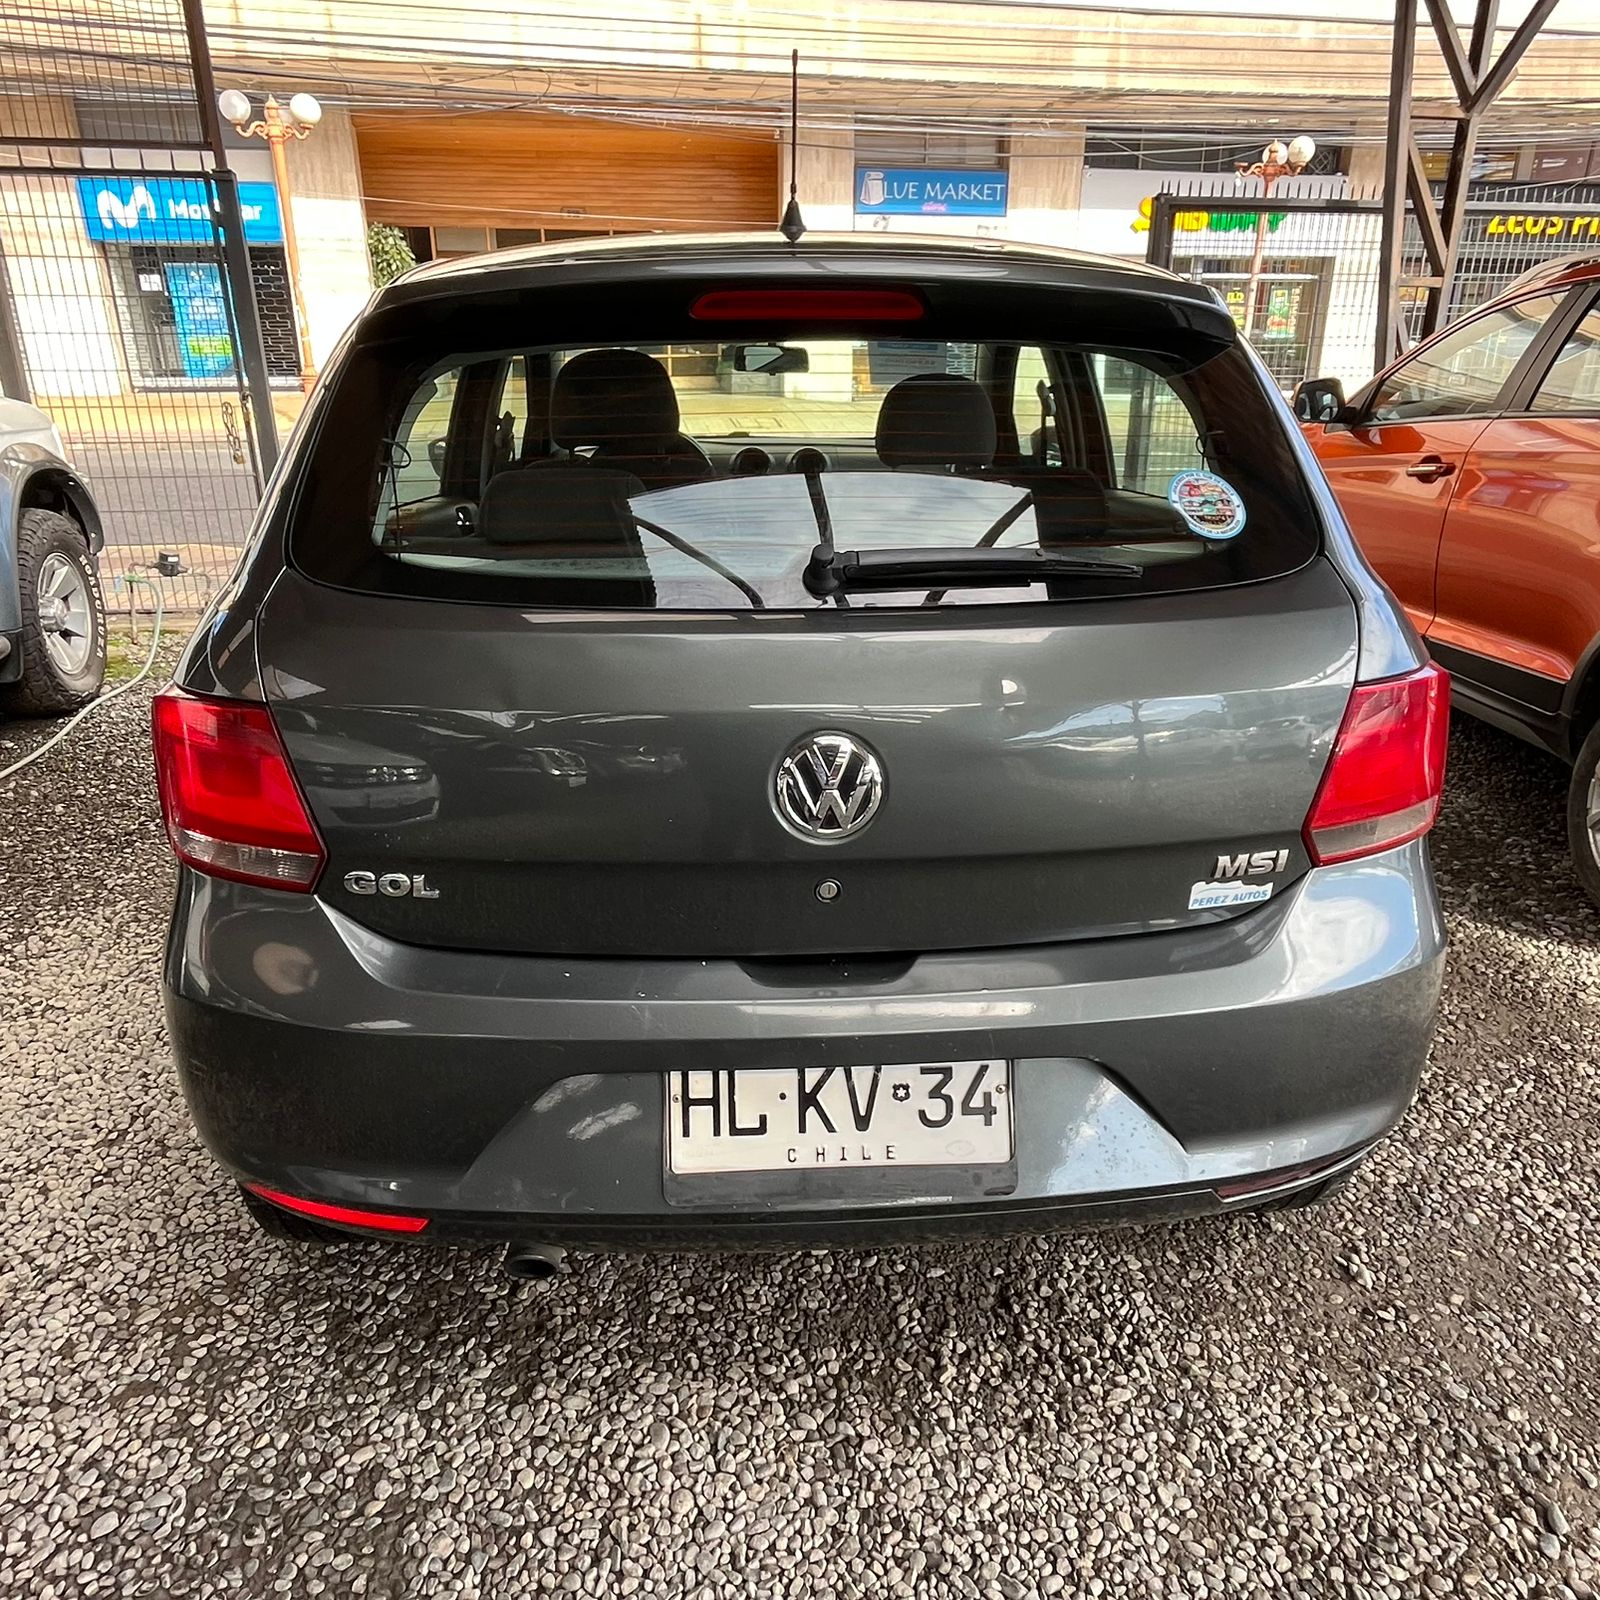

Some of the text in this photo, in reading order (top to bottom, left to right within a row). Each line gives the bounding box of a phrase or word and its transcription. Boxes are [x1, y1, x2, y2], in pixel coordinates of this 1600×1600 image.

[924, 182, 1006, 201] MARKET
[168, 198, 262, 220] Movar
[1214, 849, 1289, 878] MSI
[343, 870, 440, 898] GOL
[1191, 890, 1268, 907] PEREZ AUTOS
[787, 1145, 897, 1163] CHILE
